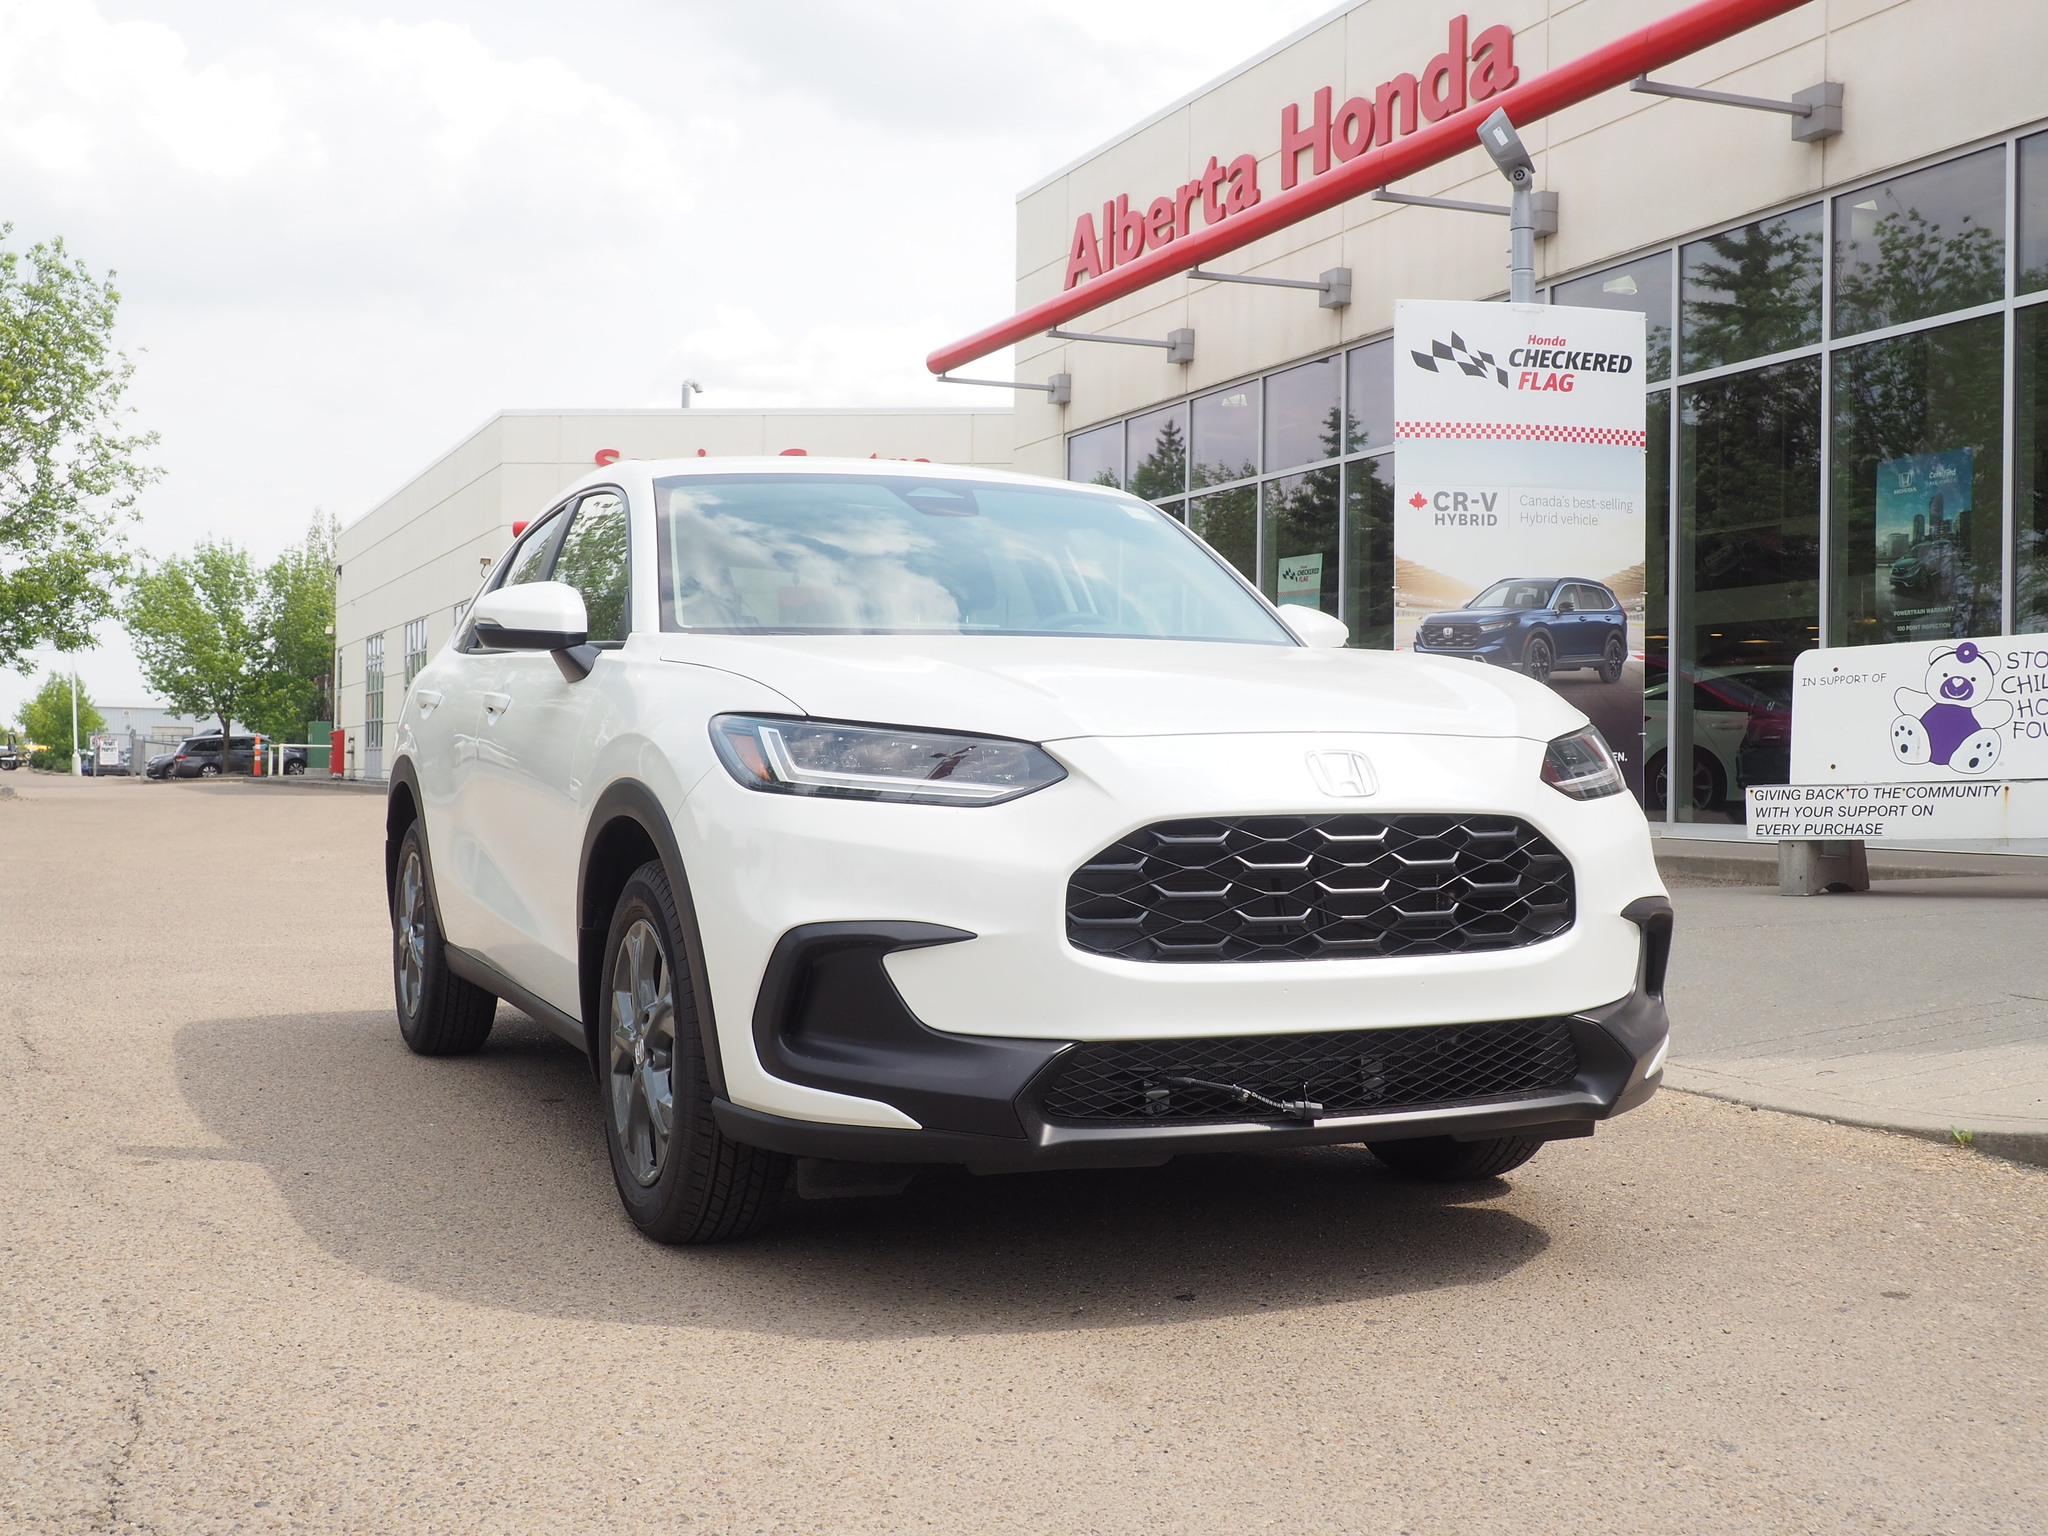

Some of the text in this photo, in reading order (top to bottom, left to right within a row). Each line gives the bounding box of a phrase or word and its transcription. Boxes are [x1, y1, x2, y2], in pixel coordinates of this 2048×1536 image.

[1064, 14, 1520, 291] Alberta Honda
[1527, 334, 1567, 347] Honda
[1508, 348, 1633, 374] CHECKERED
[1517, 371, 1575, 393] FLAG
[1893, 487, 1918, 495] HONDA
[1433, 491, 1498, 512] CR-V
[1519, 494, 1633, 514] Canada's best-selling
[1434, 513, 1498, 526] HYBRID
[1520, 512, 1558, 527] Hybrid
[1893, 606, 1955, 617] POWERTRAIN WARRANTY
[1922, 622, 1951, 630] INSPECTION
[2007, 651, 2048, 669] STO
[1802, 672, 1887, 687] IN SUPPORT OF
[1753, 785, 2002, 801] GIVING BACK TO THE COMMUNITY
[1755, 804, 1934, 818] WITH YOUR SUPPORT ON
[1755, 823, 1884, 835] EVERY PURCHASE
